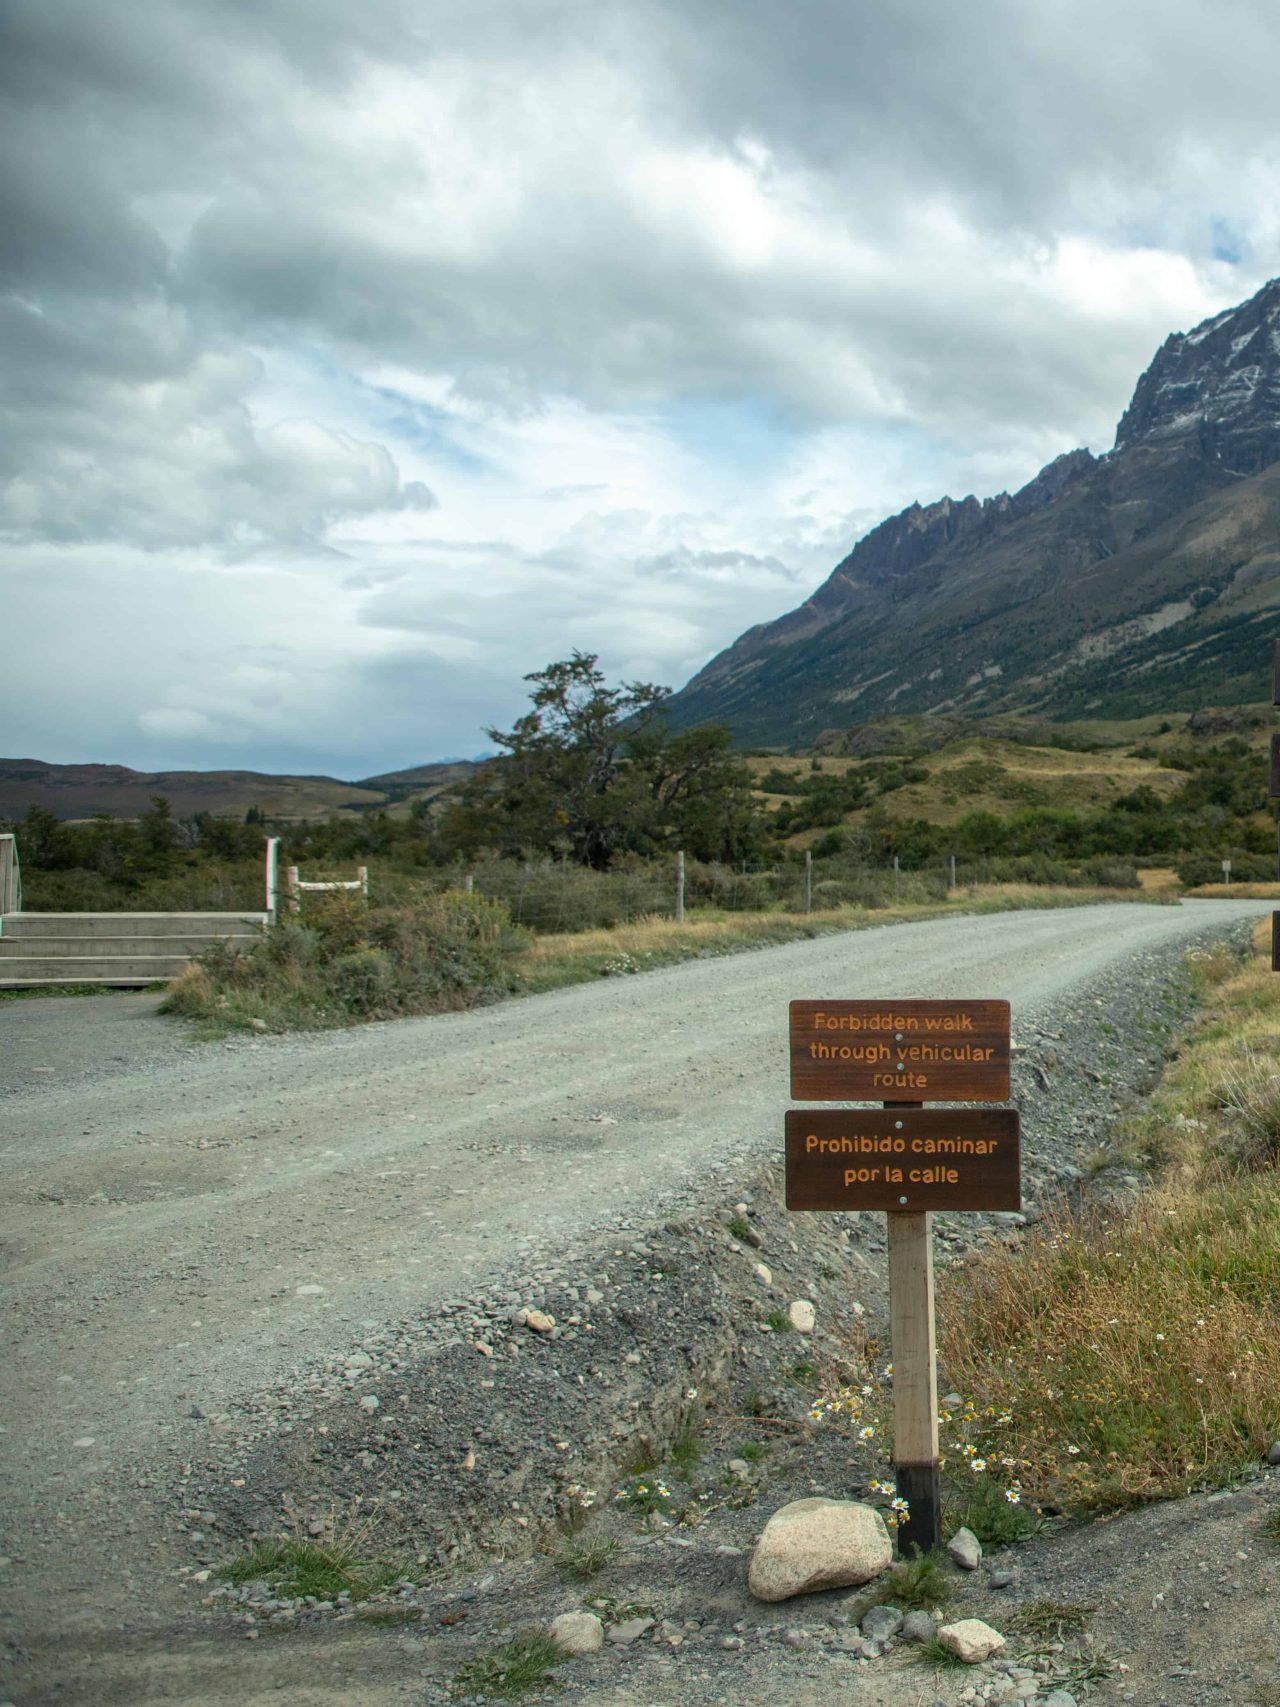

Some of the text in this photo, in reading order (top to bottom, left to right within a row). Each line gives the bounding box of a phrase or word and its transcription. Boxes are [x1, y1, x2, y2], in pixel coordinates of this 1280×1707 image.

[814, 1013, 973, 1030] Forbidden walk
[810, 1042, 994, 1063] through vehicular
[873, 1072, 927, 1087] route
[806, 1135, 998, 1154] Prohibido caminar
[844, 1166, 959, 1186] por la calle
